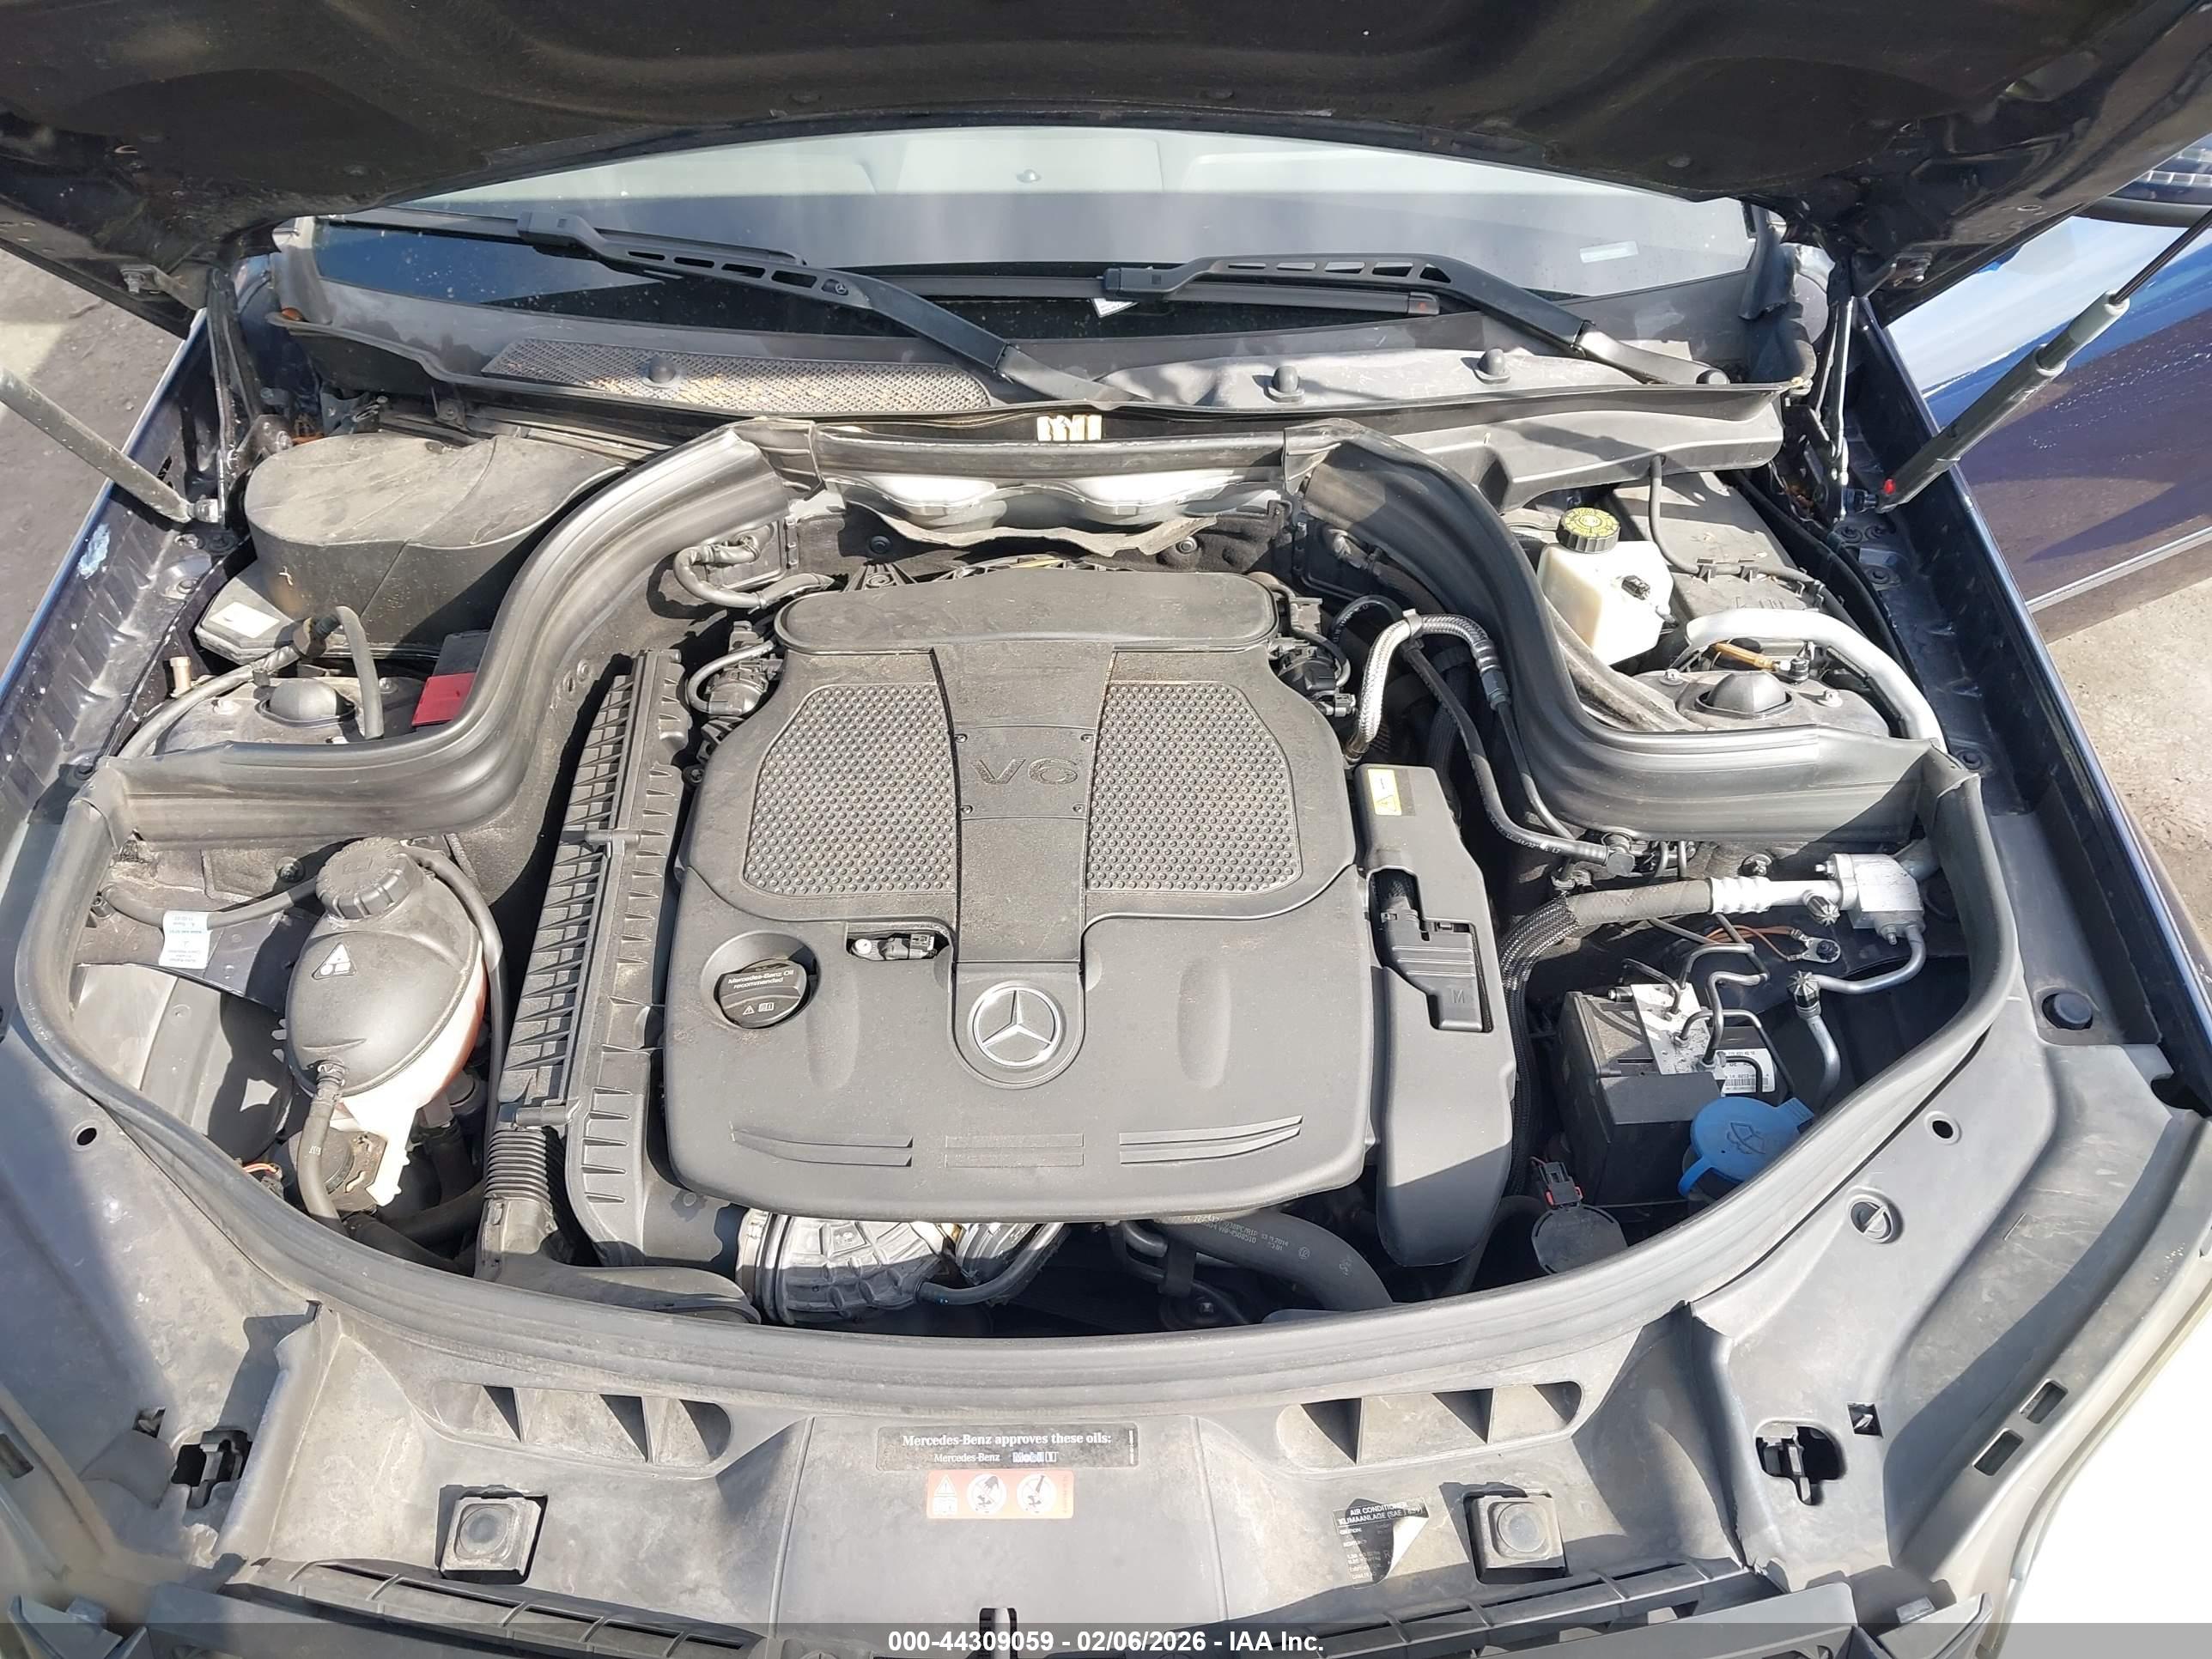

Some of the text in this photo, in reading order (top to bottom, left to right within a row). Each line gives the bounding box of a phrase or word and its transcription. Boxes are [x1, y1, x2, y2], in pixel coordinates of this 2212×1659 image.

[968, 757, 1079, 785] V6
[727, 972, 782, 985] Mercedes-Benz
[733, 977, 784, 989] recommended
[902, 1433, 1112, 1447] Mercedes-Benz approves these oils:
[933, 1452, 1000, 1463] Mercedes-Benz
[1012, 1451, 1045, 1463] Mobil
[1350, 1508, 1362, 1516] AIR
[1338, 1514, 1387, 1525] KLIMAANLAGE
